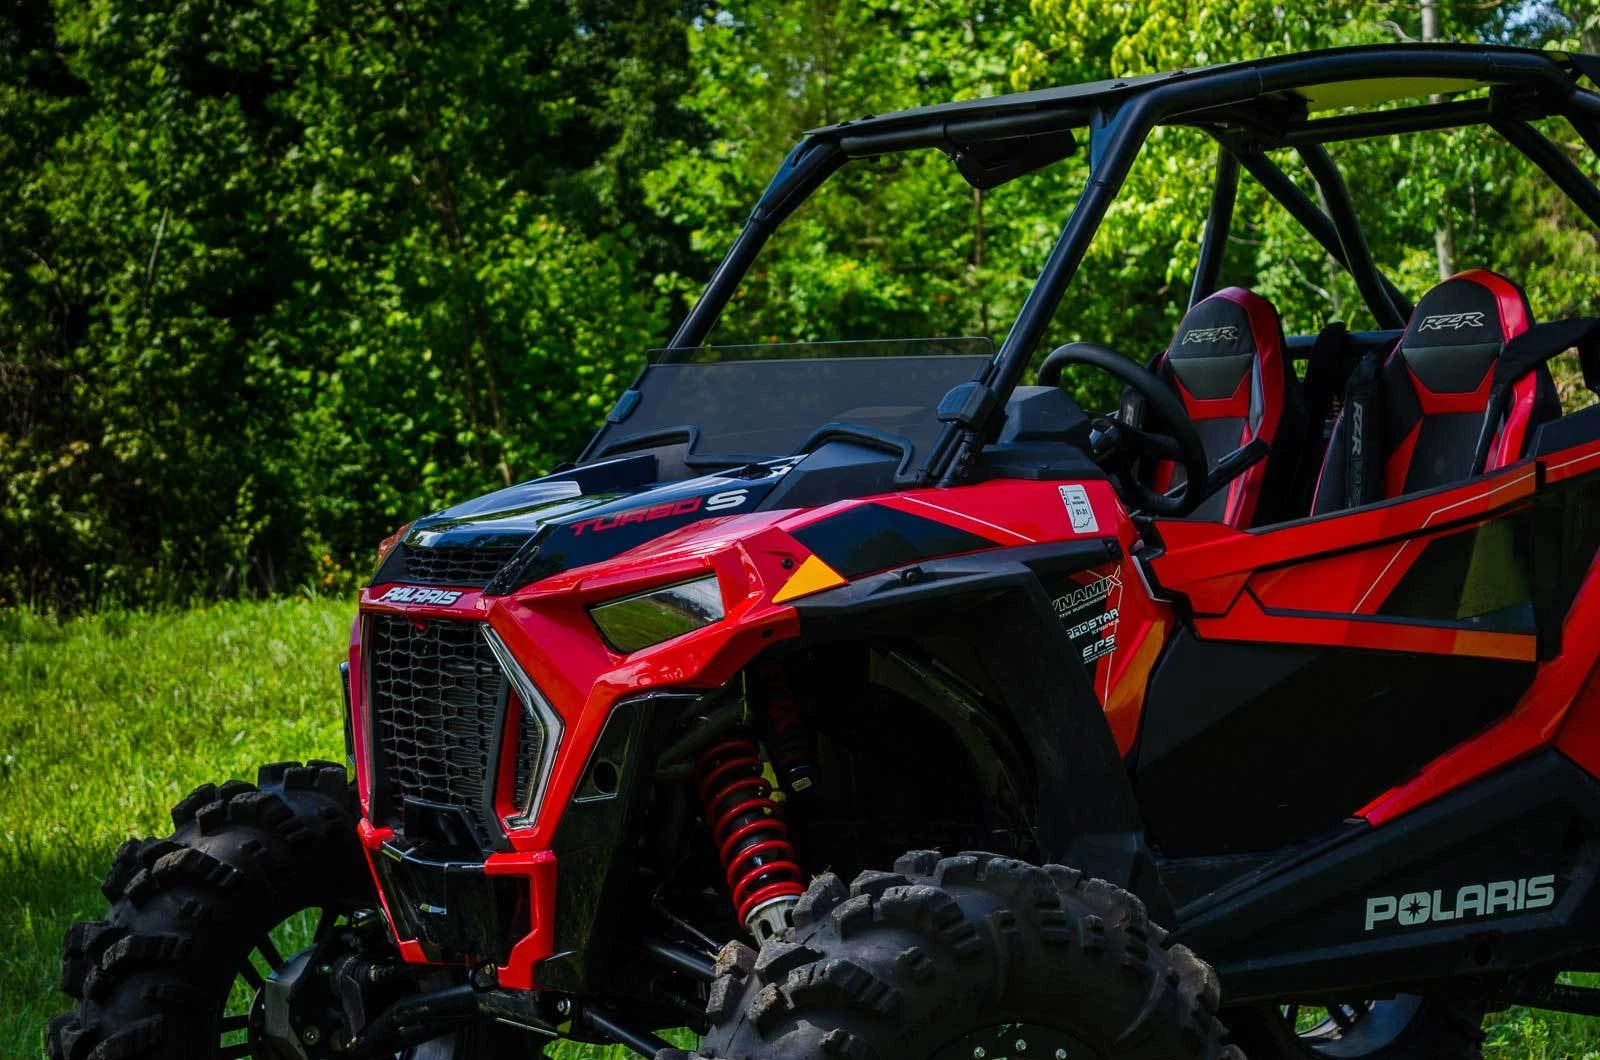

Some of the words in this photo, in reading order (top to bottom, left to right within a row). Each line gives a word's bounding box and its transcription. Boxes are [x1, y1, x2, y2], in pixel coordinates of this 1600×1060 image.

[1418, 311, 1485, 332] RZR
[1181, 326, 1239, 345] RZR
[1352, 401, 1363, 456] RZR
[570, 497, 703, 537] TURBO
[705, 488, 749, 512] S
[379, 586, 464, 606] POLARIS
[1083, 634, 1115, 658] EPS
[1365, 874, 1555, 931] POLARIS
